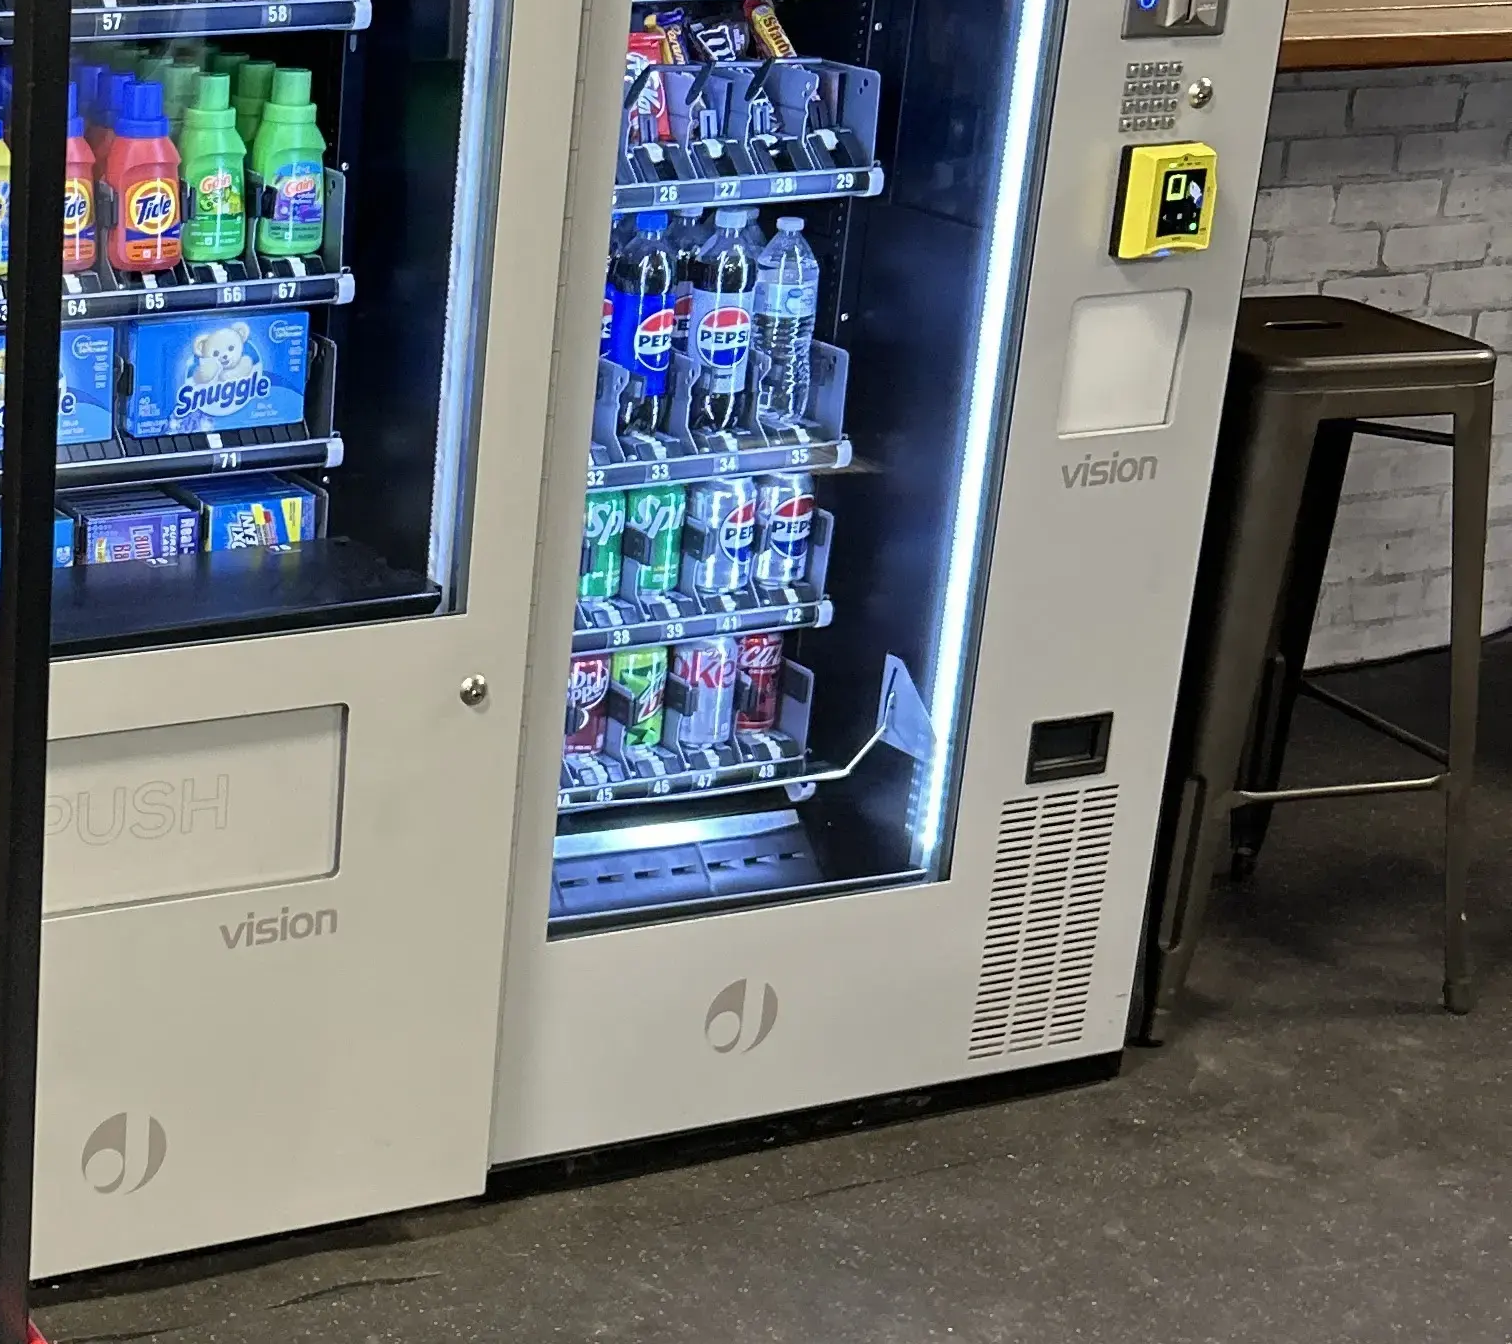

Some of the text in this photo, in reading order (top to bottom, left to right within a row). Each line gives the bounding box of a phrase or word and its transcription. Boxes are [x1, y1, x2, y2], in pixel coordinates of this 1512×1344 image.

[268, 5, 288, 23] 58
[102, 12, 122, 32] 57
[776, 178, 793, 192] 28
[837, 174, 854, 188] 29
[660, 186, 677, 202] 26
[720, 182, 737, 197] 27
[135, 194, 172, 225] Tide
[223, 287, 242, 303] 66
[278, 282, 296, 299] 67
[67, 299, 87, 316] 64
[145, 293, 165, 310] 65
[639, 334, 671, 347] PEP
[175, 371, 269, 416] Snuggle
[220, 454, 236, 468] 71
[791, 449, 808, 464] 35
[651, 464, 669, 480] 33
[720, 457, 737, 472] 34
[1061, 454, 1158, 490] vision
[587, 471, 604, 485] 32
[725, 524, 755, 540] PEP
[723, 616, 738, 630] 41
[786, 608, 801, 623] 42
[613, 630, 630, 645] 38
[667, 624, 684, 638] 39
[759, 765, 775, 778] 48
[653, 780, 670, 793] 46
[697, 774, 712, 787] 47
[596, 788, 613, 802] 45
[45, 774, 229, 846] PUSH
[220, 906, 338, 950] vision
